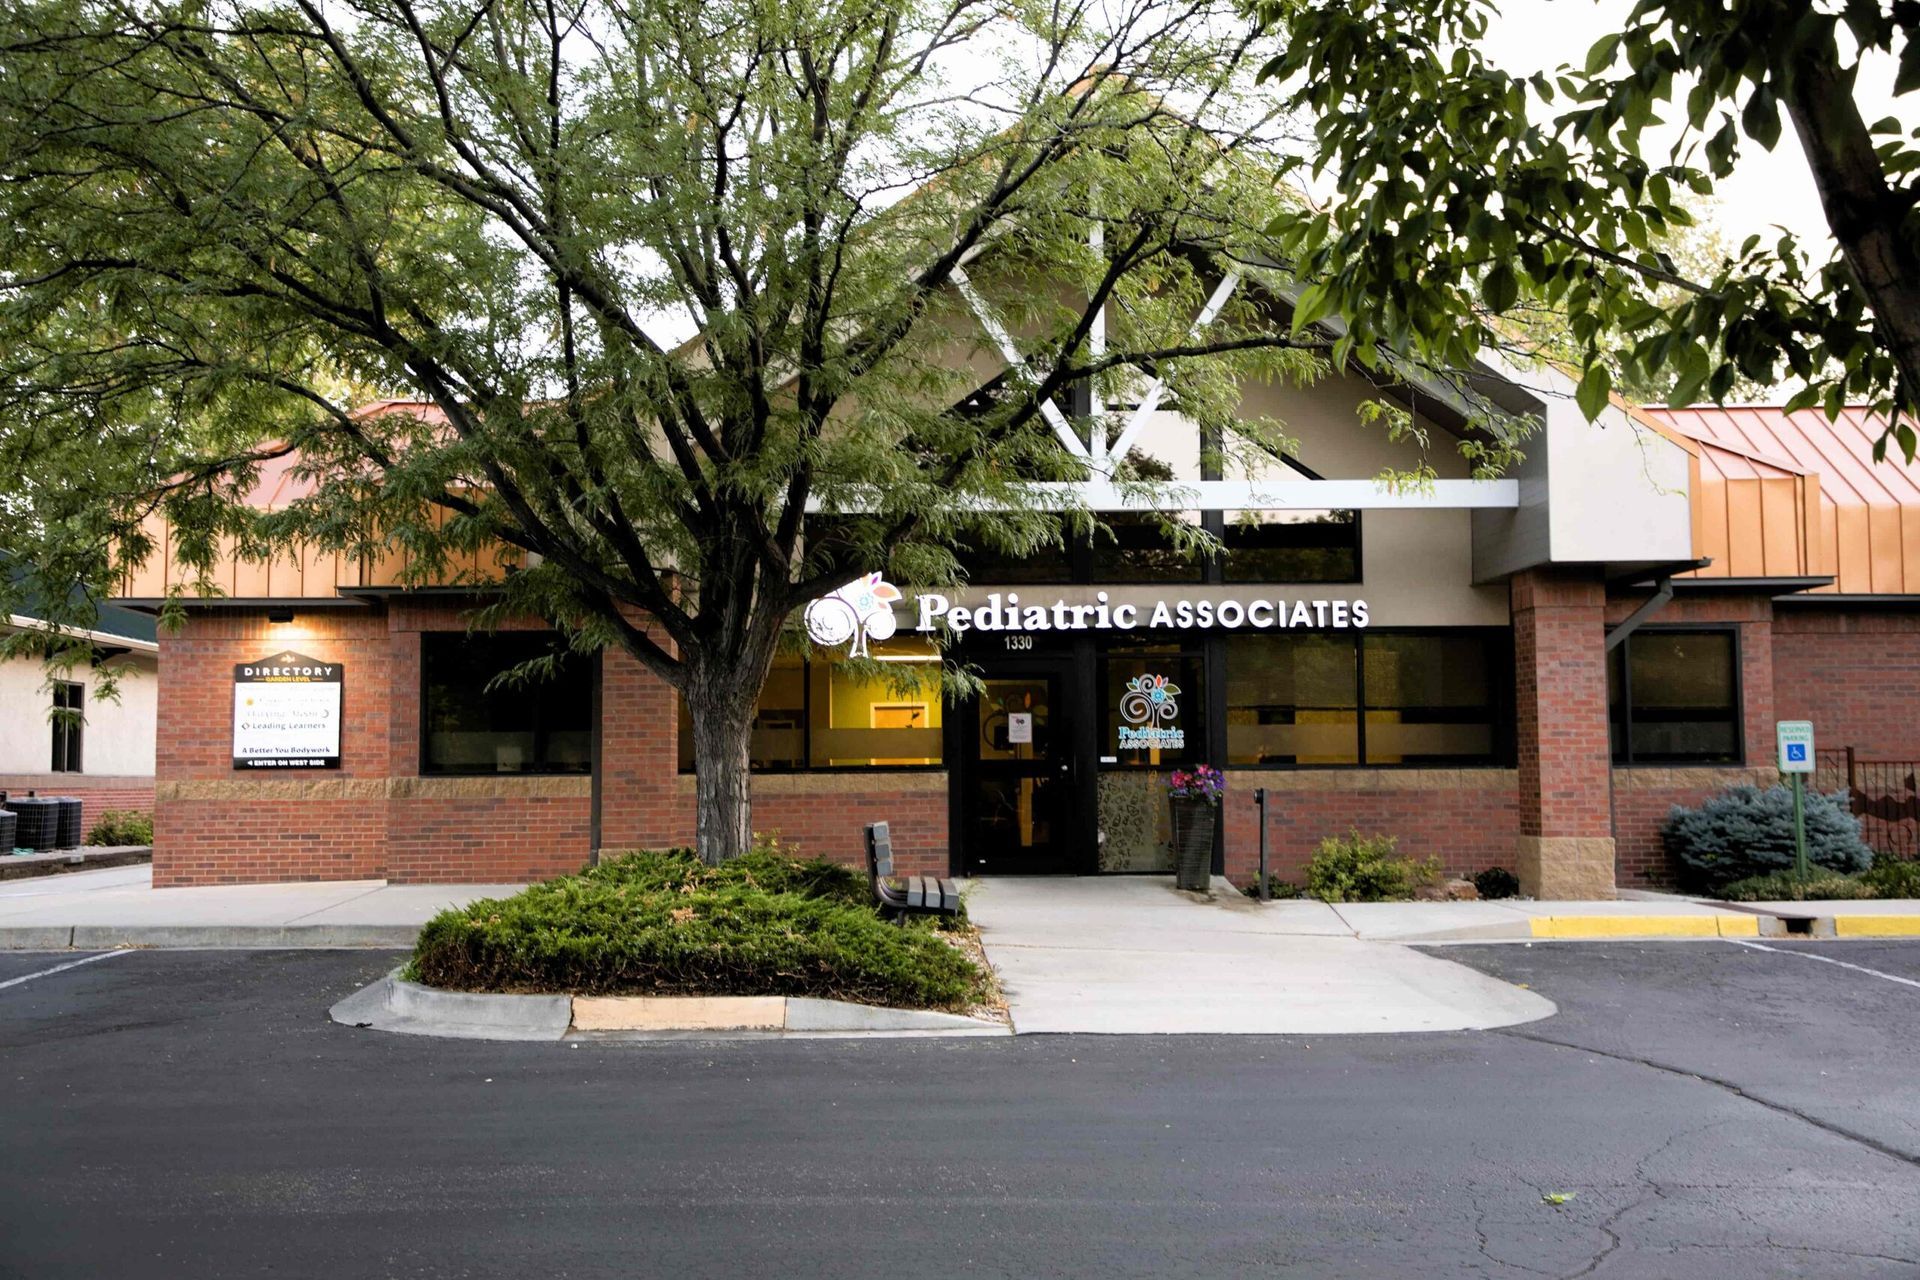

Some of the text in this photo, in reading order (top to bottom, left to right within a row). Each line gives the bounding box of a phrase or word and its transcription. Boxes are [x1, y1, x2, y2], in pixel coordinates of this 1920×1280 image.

[915, 592, 1369, 632] Pediatric ASSOCIATES
[1004, 635, 1033, 650] 1330
[244, 667, 332, 676] DIRECTORY
[252, 722, 286, 730] Leading
[1118, 726, 1184, 739] Pediatric
[1119, 739, 1185, 749] ASSOCIATES
[291, 746, 330, 754] Bodywork
